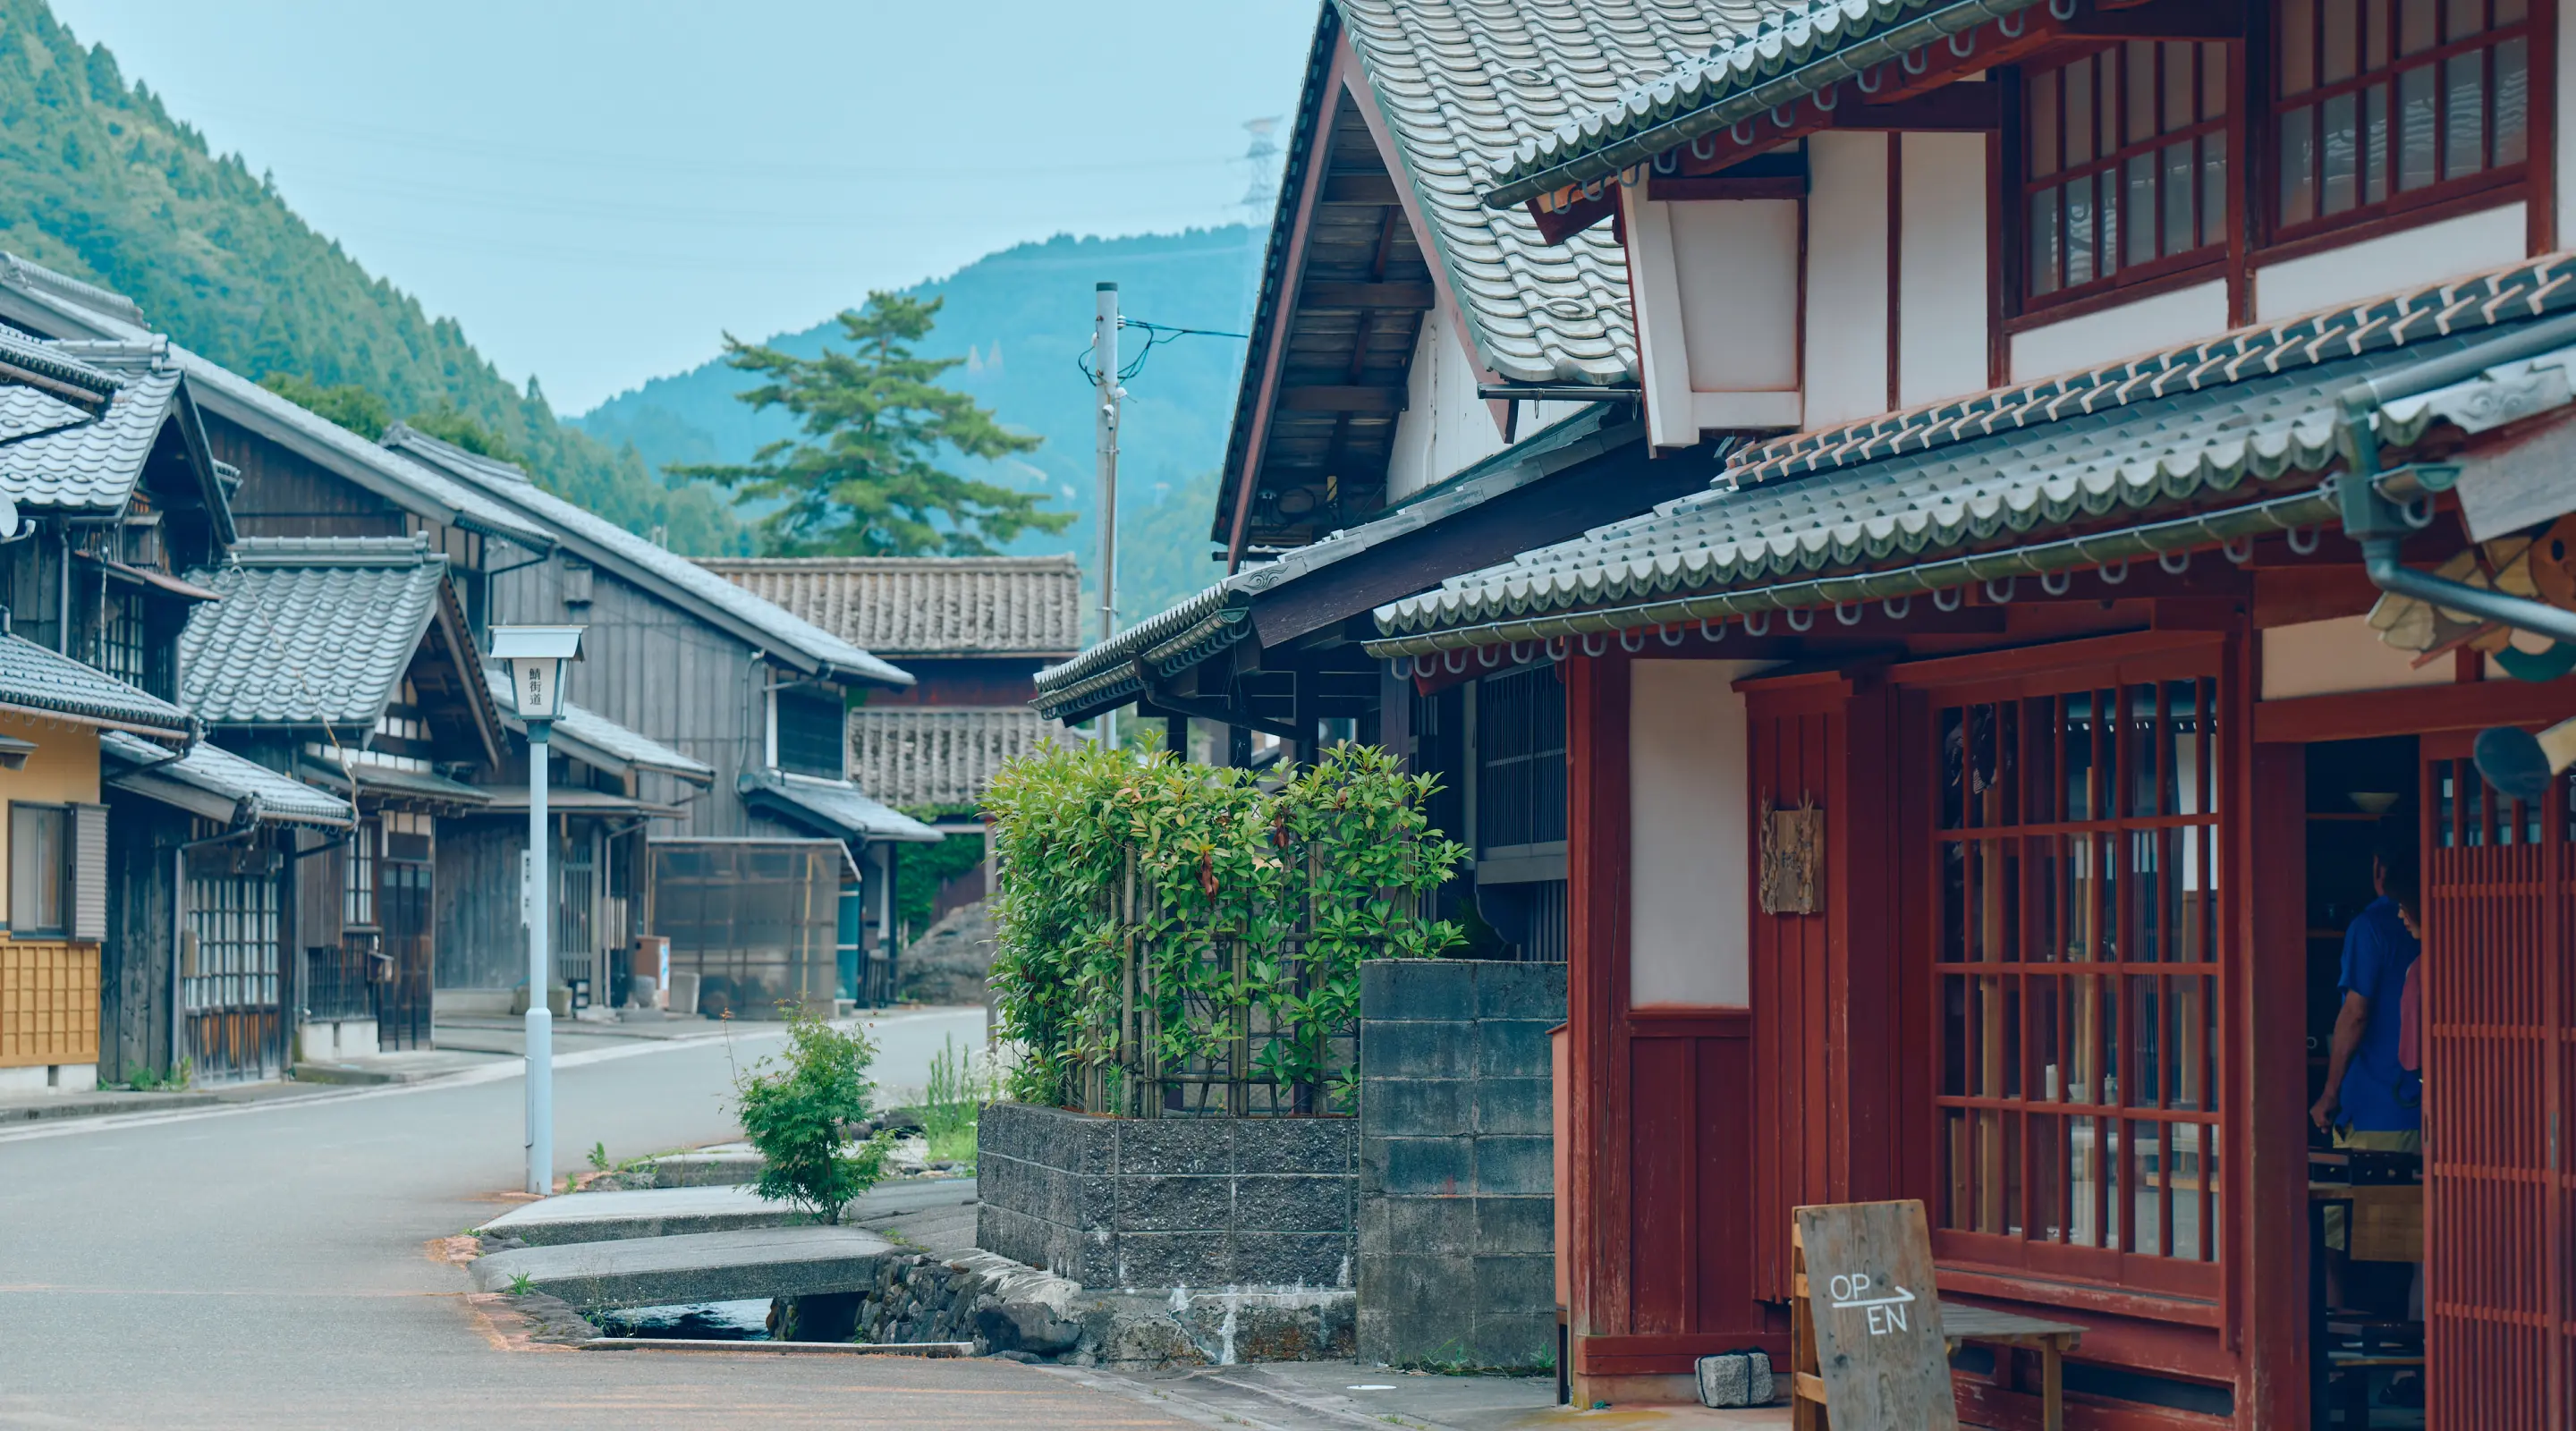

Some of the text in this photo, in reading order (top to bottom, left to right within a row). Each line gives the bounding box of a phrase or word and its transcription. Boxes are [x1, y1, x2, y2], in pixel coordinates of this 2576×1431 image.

[529, 667, 541, 705] 鯖街道
[1830, 1273, 1870, 1300] OP
[1867, 1303, 1908, 1335] EN
